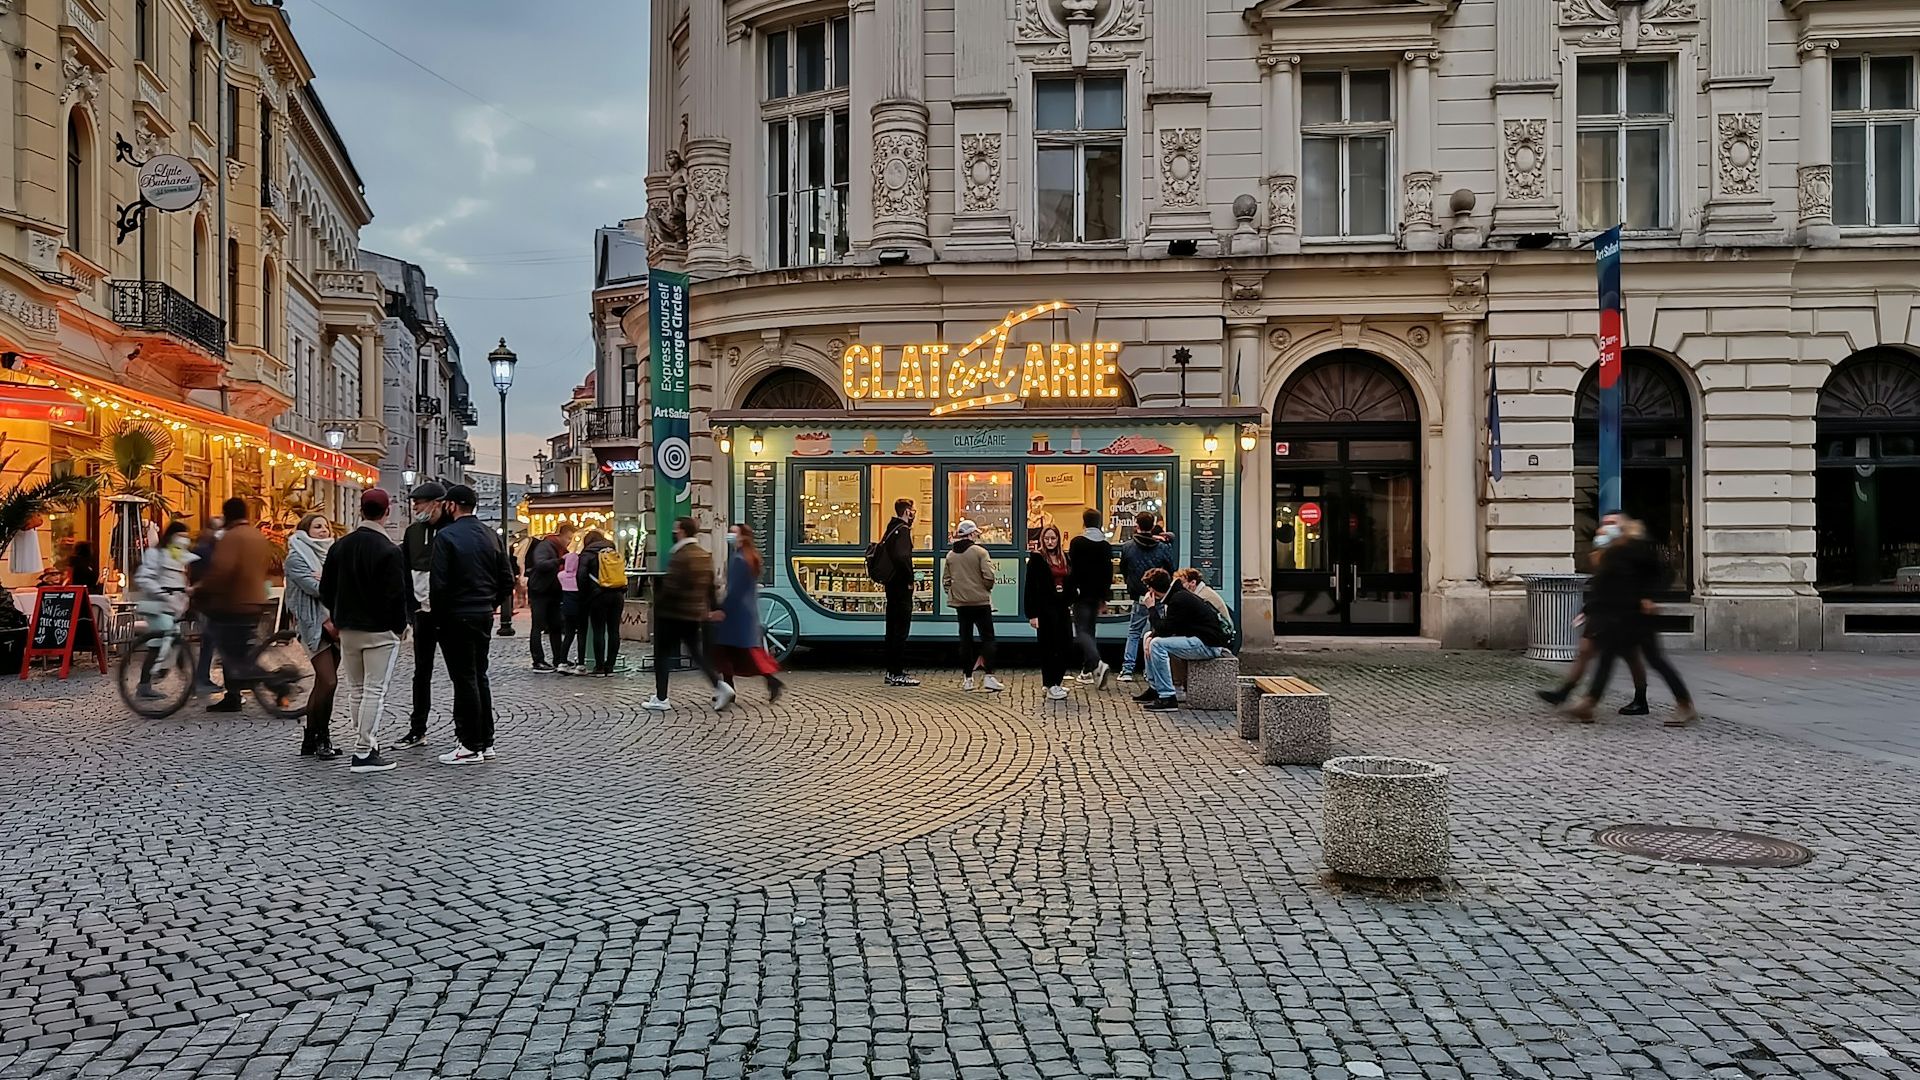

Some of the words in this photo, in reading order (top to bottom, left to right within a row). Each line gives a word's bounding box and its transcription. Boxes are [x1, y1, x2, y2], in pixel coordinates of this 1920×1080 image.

[155, 163, 182, 178] Little
[141, 173, 191, 188] Bucharest
[658, 282, 673, 337] yourself
[672, 285, 683, 329] Circles
[673, 331, 686, 377] George
[661, 340, 672, 392] Express
[843, 344, 949, 399] CLAT
[1020, 343, 1120, 398] ARIE
[674, 381, 685, 392] in
[654, 406, 668, 418] Art
[669, 408, 690, 420] Safar
[954, 435, 974, 446] CLAT
[987, 435, 1006, 446] ARIE
[1110, 487, 1137, 500] Collect
[1139, 490, 1158, 501] your
[1110, 515, 1138, 527] Thank
